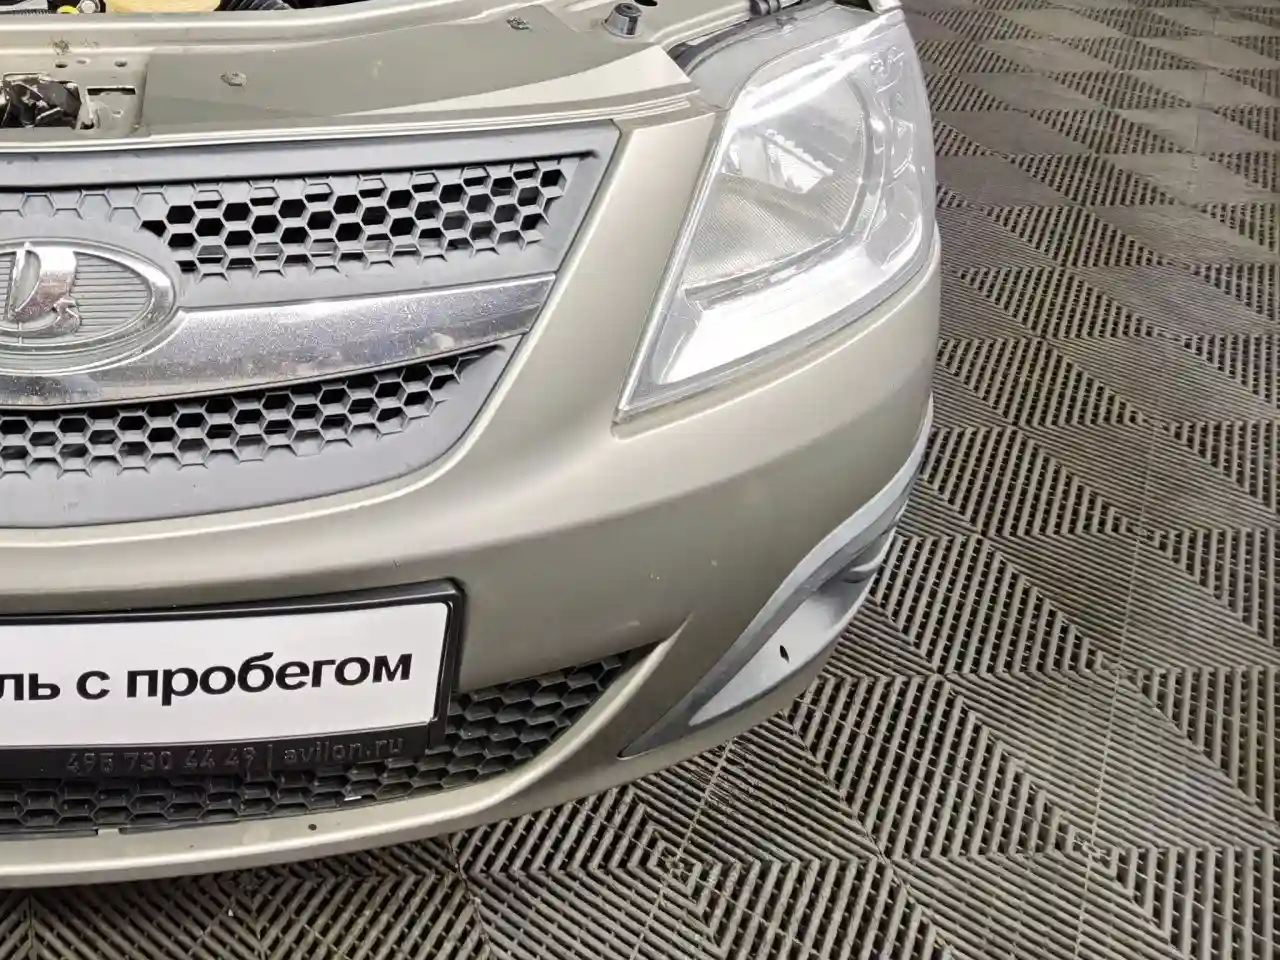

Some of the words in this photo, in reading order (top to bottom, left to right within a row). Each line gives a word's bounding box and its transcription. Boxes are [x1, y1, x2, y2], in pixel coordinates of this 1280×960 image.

[77, 671, 109, 699] с
[127, 652, 412, 706] пробегом
[66, 752, 114, 776] 495
[123, 750, 172, 773] 730
[183, 748, 216, 770] 44
[283, 736, 404, 766] avilon.ru
